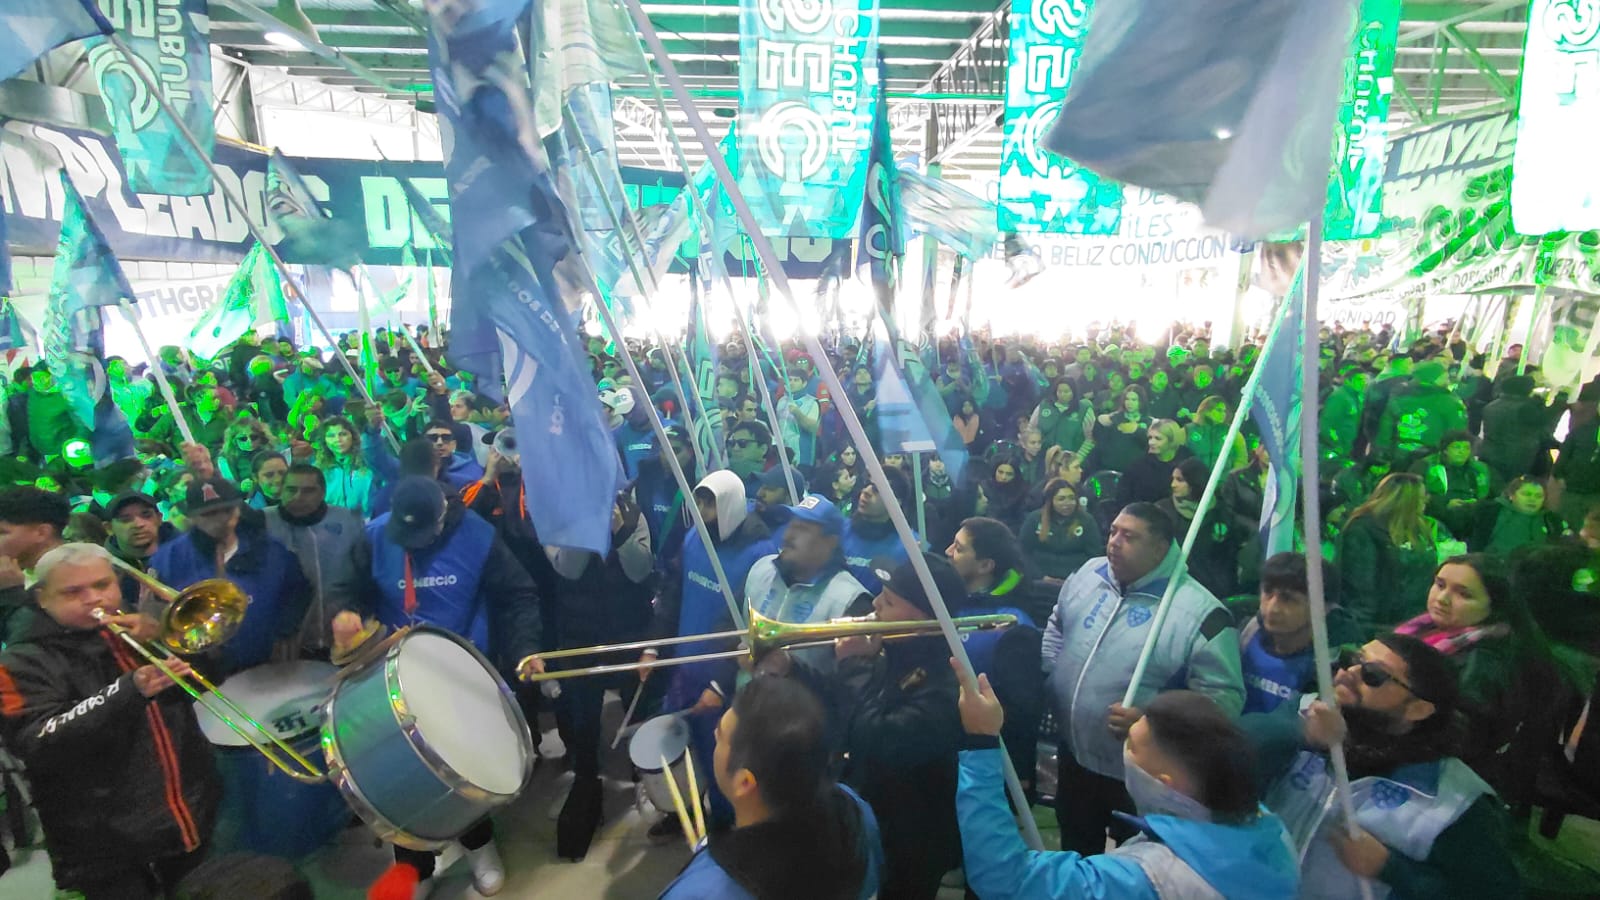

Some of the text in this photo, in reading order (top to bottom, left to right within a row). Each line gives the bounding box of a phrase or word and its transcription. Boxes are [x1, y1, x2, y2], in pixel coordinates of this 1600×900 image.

[832, 8, 860, 156] CHUBUT
[1348, 20, 1383, 159] CHUBUT
[1050, 244, 1106, 267] BELIZ
[1109, 234, 1227, 267] CONDUCCION
[398, 574, 458, 589] CMERCIO
